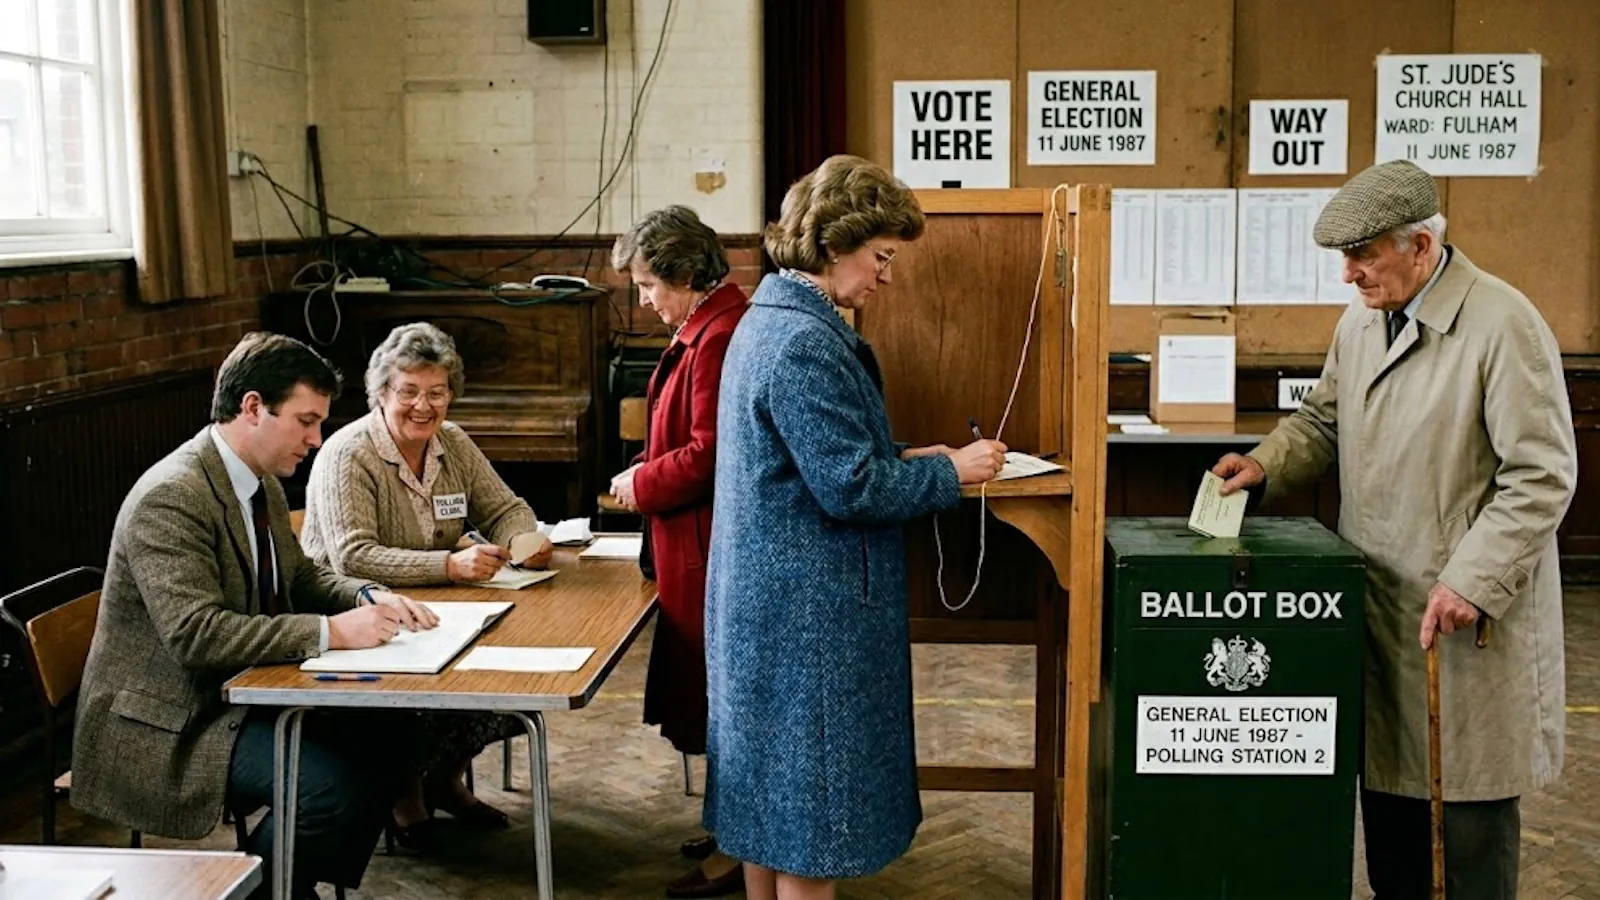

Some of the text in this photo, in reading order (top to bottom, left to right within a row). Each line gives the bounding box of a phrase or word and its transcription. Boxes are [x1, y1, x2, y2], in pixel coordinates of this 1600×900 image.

[1401, 60, 1516, 85] ST. JUDE'S
[1043, 80, 1141, 102] GENERAL
[1395, 89, 1527, 109] CHURCH HALL
[910, 90, 993, 123] VOTE
[1041, 107, 1143, 129] ELECTION
[1269, 107, 1328, 134] WAY
[1384, 116, 1517, 134] WARD: FULHAM
[911, 129, 993, 161] HERE
[1038, 135, 1146, 151] 11 JUNE 1987
[1272, 140, 1325, 167] OUT
[1406, 143, 1517, 160] 11 JUNE 1987
[1141, 591, 1343, 619] BALLOT BOX
[1146, 706, 1328, 723] GENERAL ELECTION
[1170, 728, 1185, 743] 11
[1192, 728, 1240, 743] JUNE
[1248, 728, 1289, 743] 1987
[1146, 748, 1325, 764] POLLING STATION 2
